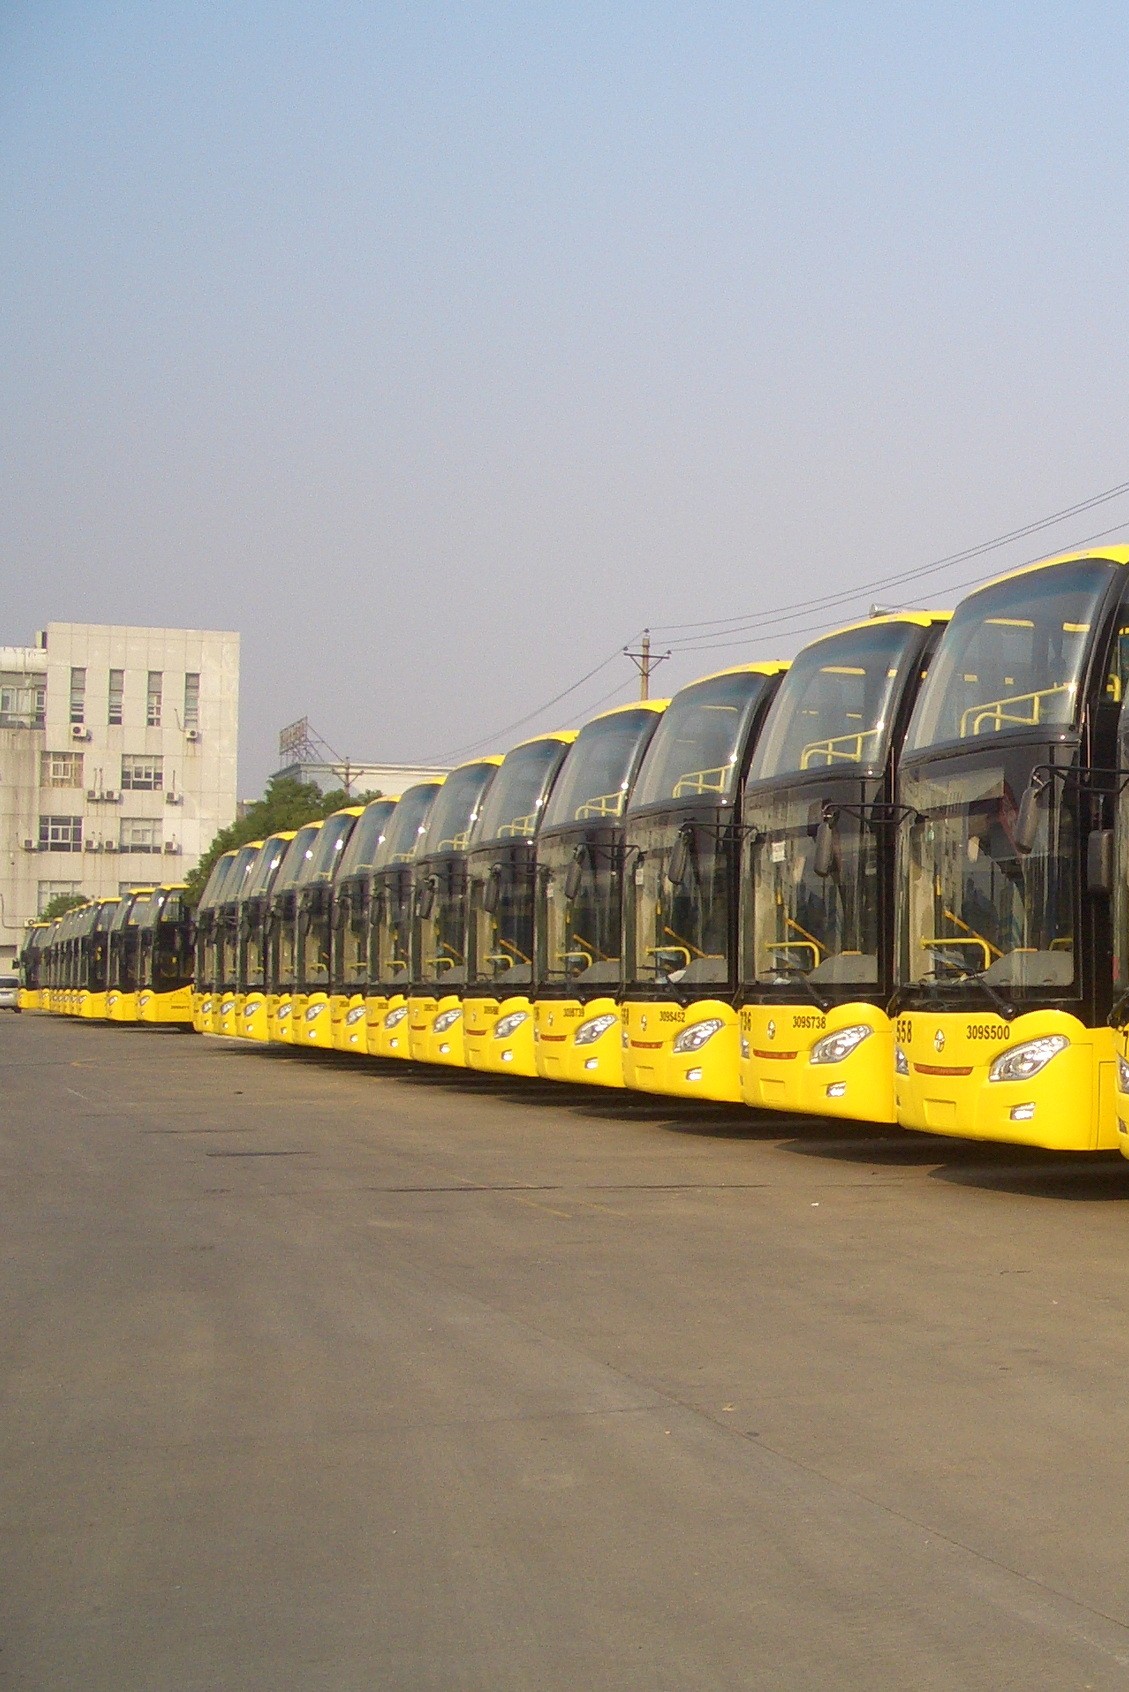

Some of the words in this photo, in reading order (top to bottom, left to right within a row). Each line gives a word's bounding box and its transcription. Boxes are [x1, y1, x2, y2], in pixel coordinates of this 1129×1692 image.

[792, 1015, 826, 1029] 309S738
[896, 1020, 912, 1043] 558
[966, 1025, 1010, 1040] 309S500
